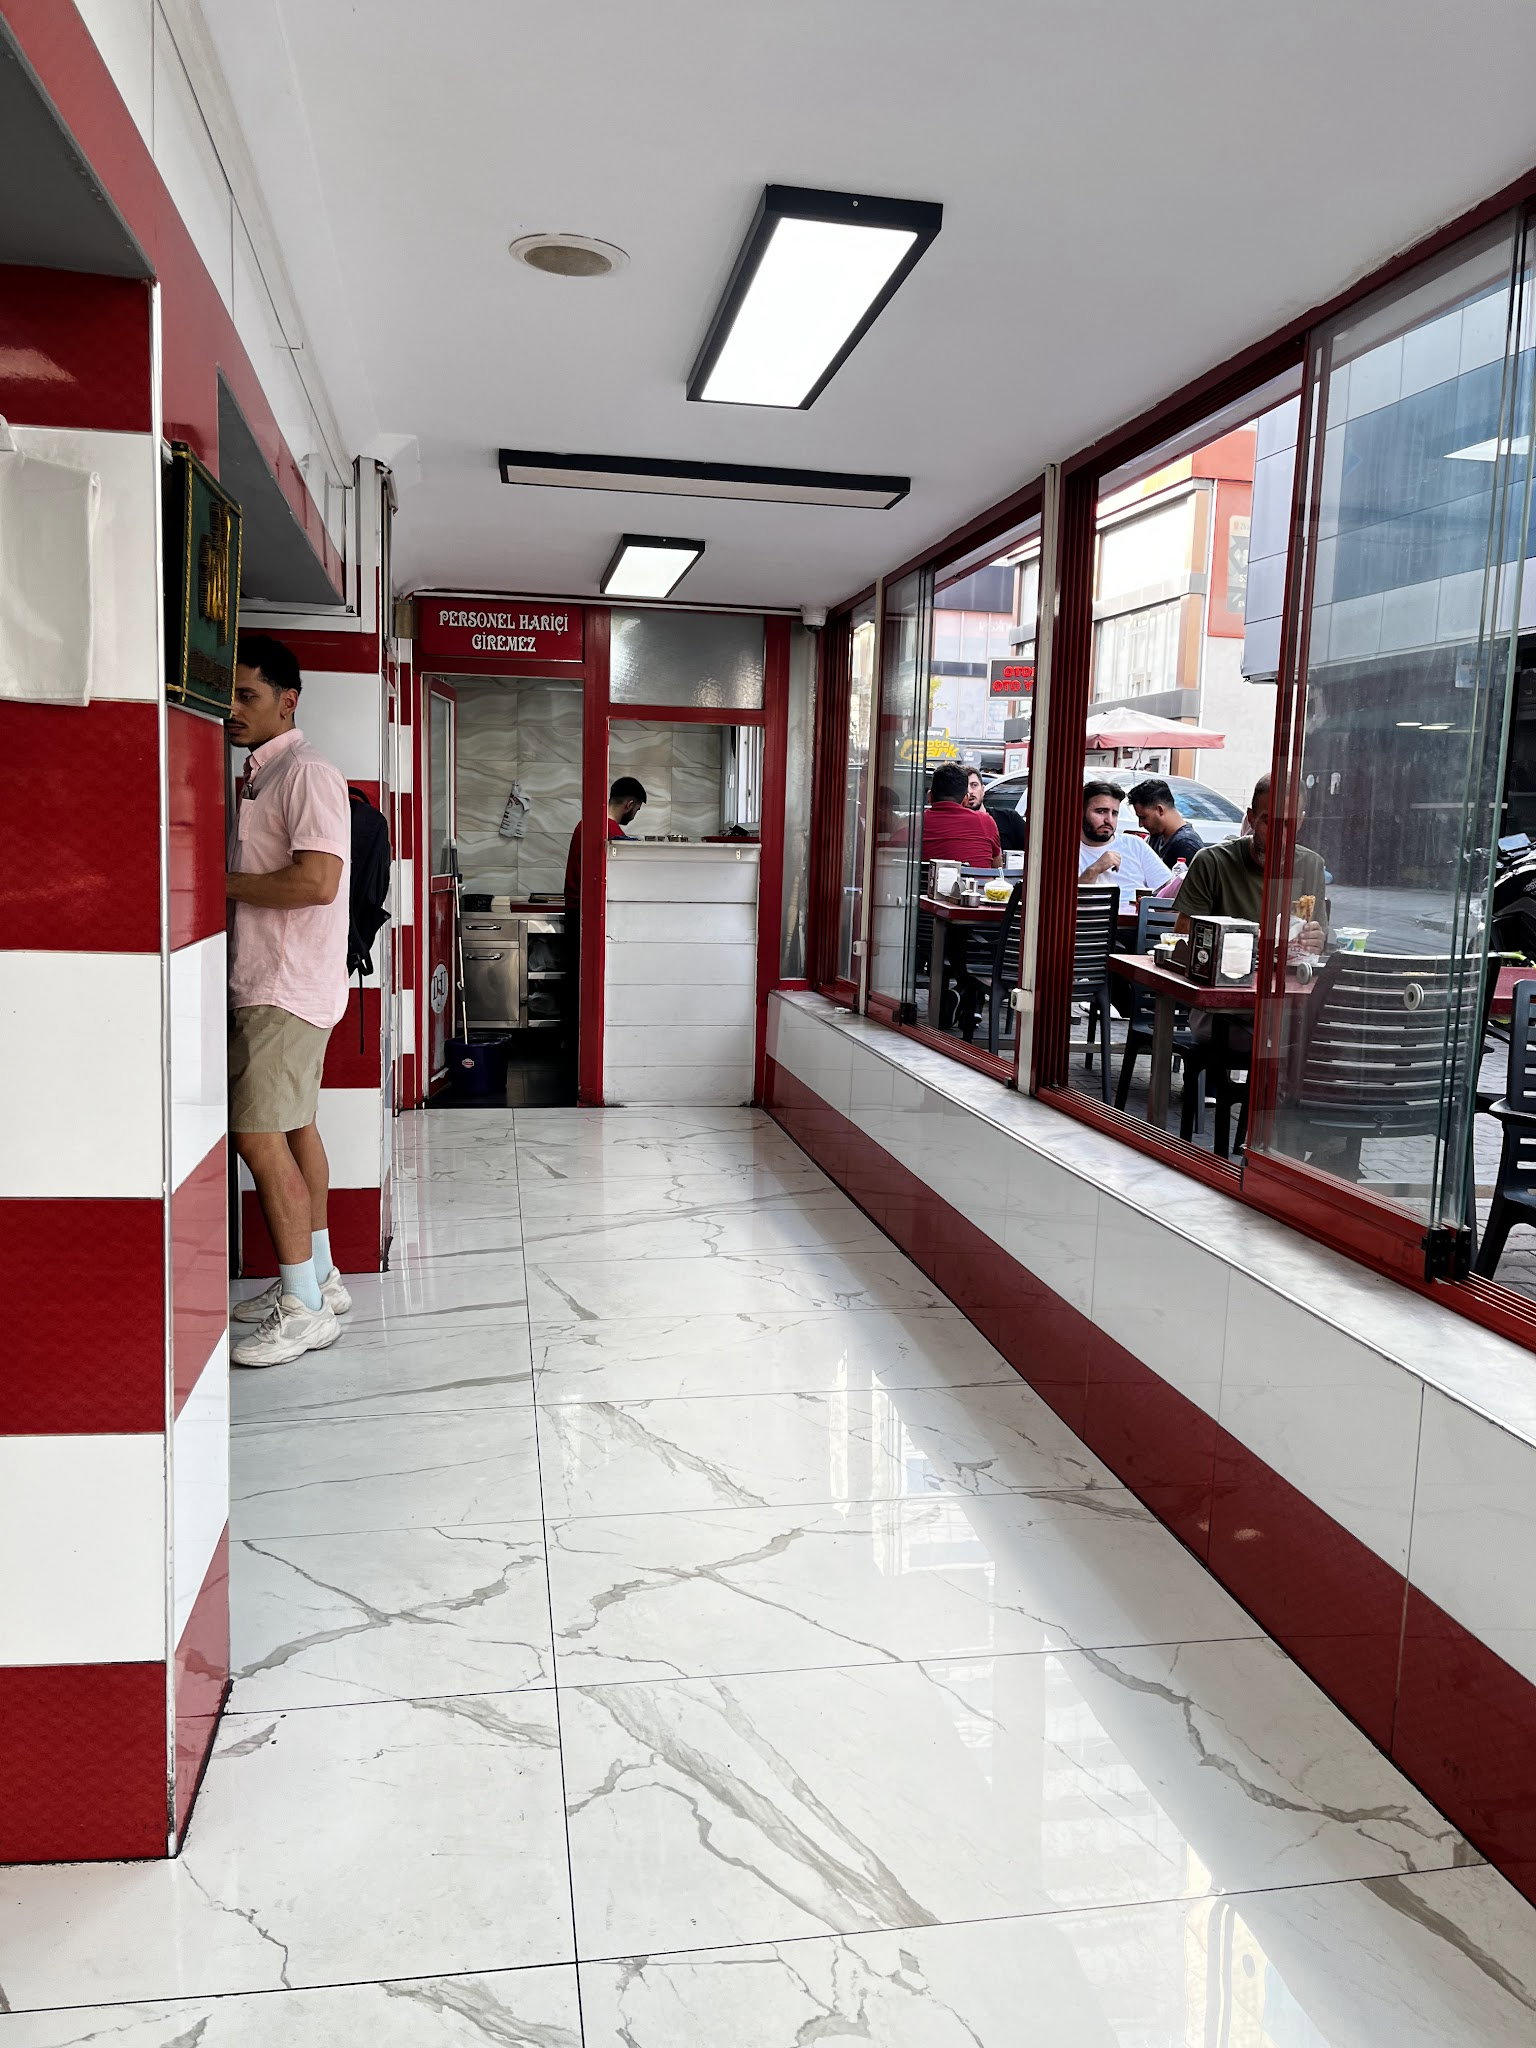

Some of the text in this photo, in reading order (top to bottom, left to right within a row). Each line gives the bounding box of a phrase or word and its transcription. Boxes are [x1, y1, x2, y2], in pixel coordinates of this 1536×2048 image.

[439, 610, 568, 635] PERSONEL HARİÇİ
[472, 632, 536, 652] GİREMEZ
[992, 679, 1021, 693] OTO
